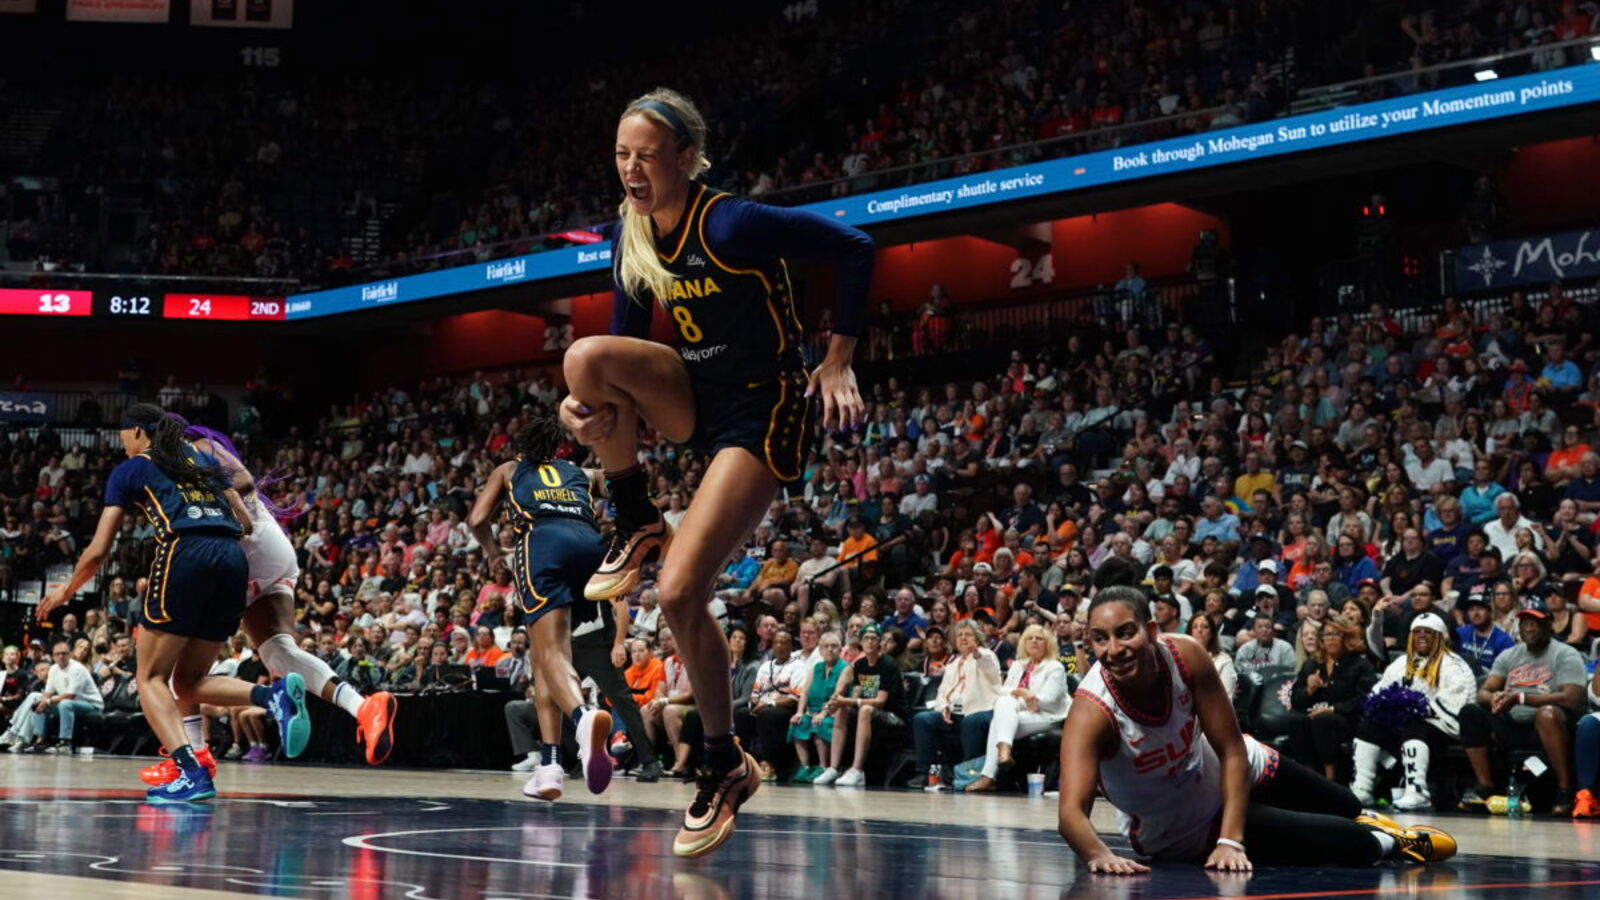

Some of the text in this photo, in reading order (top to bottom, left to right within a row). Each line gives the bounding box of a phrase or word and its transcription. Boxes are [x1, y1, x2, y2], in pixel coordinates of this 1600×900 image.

[240, 47, 280, 67] 115
[1113, 79, 1573, 171] Book through Mohegan Sun to utilize your Momentum points
[867, 173, 1043, 214] Complimentary shuttle service
[486, 259, 526, 280] Fairfield
[1010, 253, 1056, 288] 24
[361, 281, 398, 301] Fairfield
[670, 277, 722, 300] ANA
[38, 294, 71, 312] 13
[110, 297, 150, 314] 8:12
[188, 299, 212, 315] 24
[251, 302, 279, 315] 2ND
[672, 305, 703, 343] 8
[543, 324, 574, 352] 23
[538, 463, 561, 487] 0
[533, 487, 577, 502] MITCHELL
